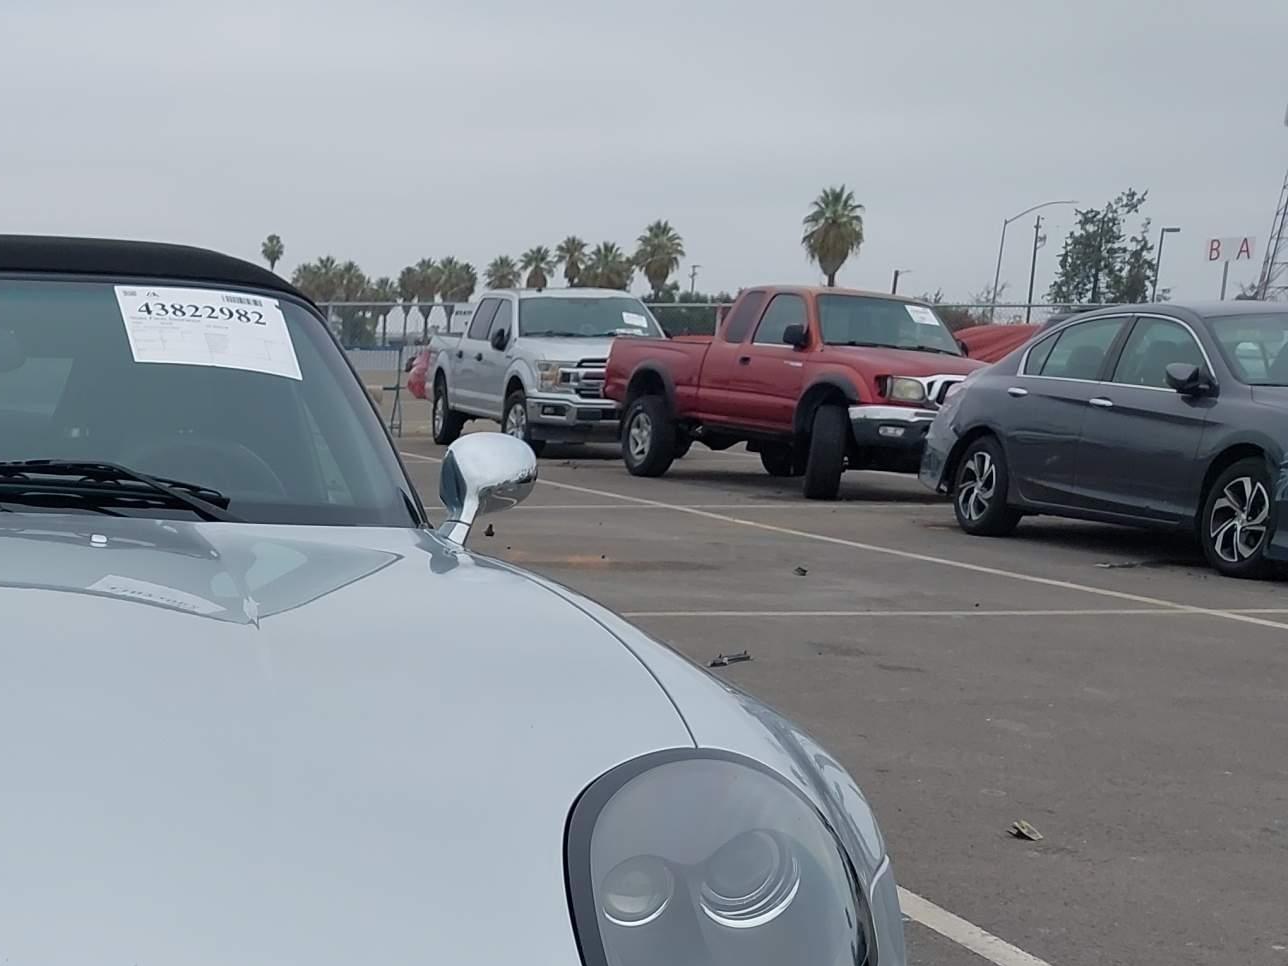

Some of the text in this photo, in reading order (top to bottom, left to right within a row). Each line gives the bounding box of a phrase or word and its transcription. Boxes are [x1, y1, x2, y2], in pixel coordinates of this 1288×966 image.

[1209, 237, 1250, 261] B A
[137, 302, 267, 326] 43822982
